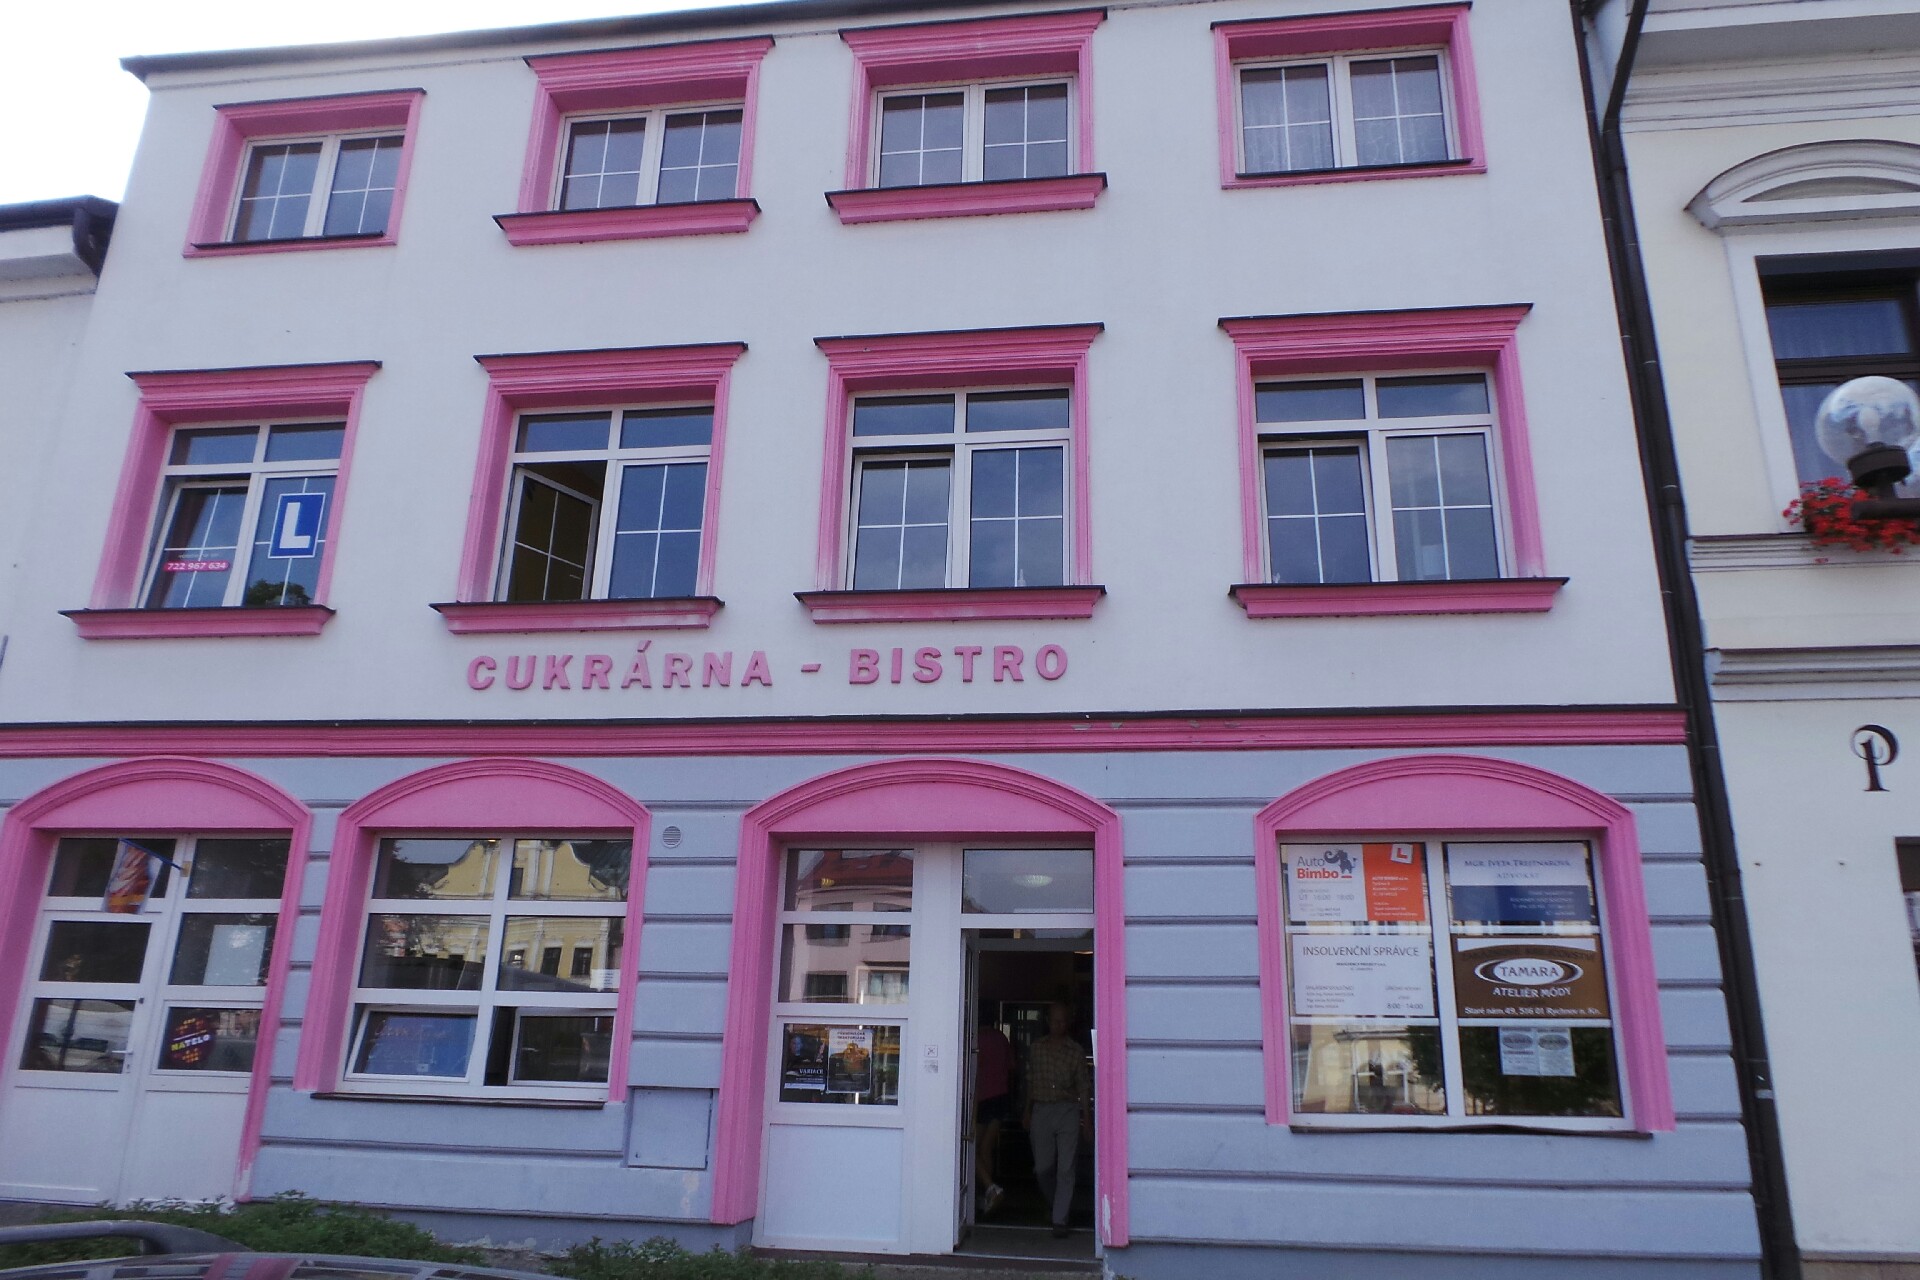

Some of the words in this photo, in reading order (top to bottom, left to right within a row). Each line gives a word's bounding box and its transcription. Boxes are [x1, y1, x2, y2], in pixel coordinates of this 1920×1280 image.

[279, 502, 311, 549] L
[167, 562, 186, 571] 722
[208, 561, 226, 570] 634
[467, 640, 773, 690] CUKRÁRNA
[849, 643, 1068, 684] BISTRO
[1297, 856, 1325, 867] Auto
[1297, 868, 1339, 879] Bimbo
[1303, 945, 1371, 957] INSOLVENČNÍ
[1373, 945, 1420, 957] SPRÁVCE
[1500, 966, 1559, 977] TAMARA
[1492, 986, 1540, 998] ATELIÉR
[1540, 986, 1571, 998] MÓDY
